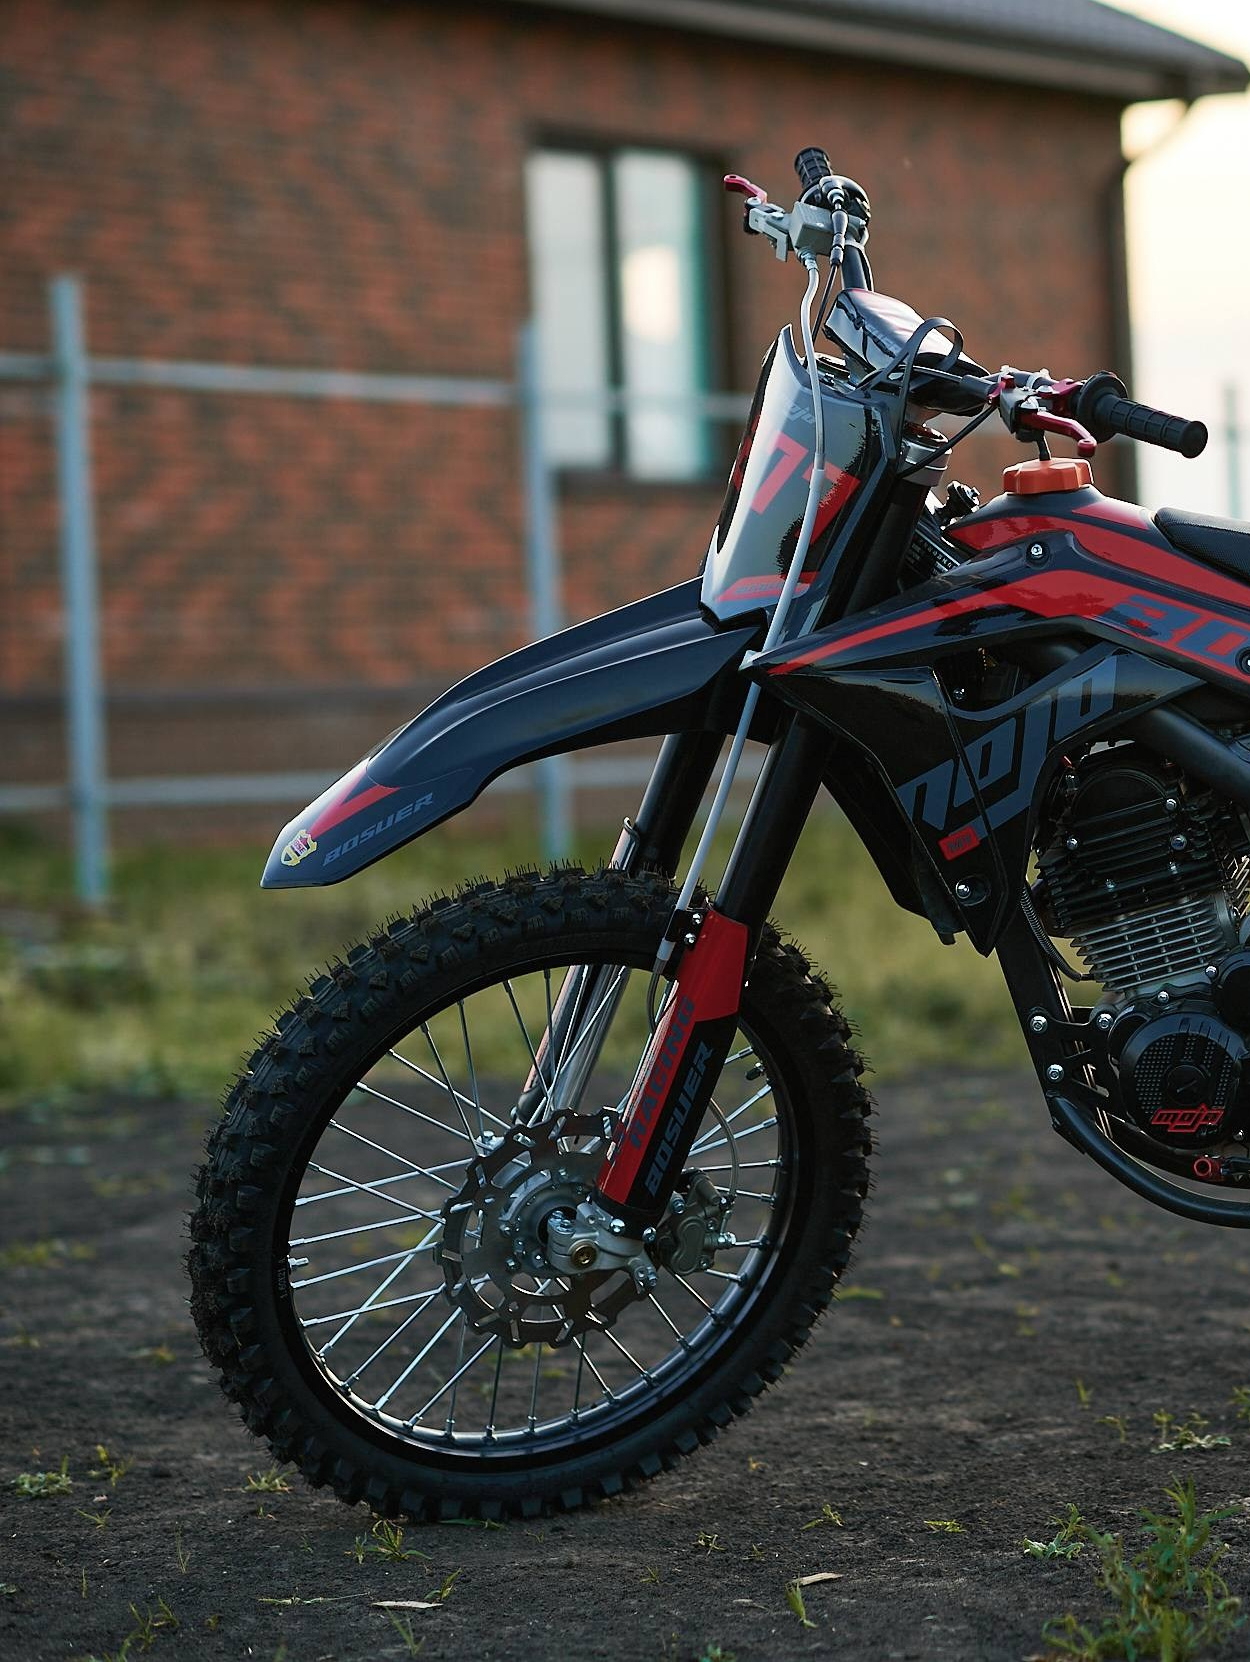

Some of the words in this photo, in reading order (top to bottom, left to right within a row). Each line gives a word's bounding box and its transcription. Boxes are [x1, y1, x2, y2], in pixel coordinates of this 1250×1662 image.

[322, 793, 433, 867] BOSUER
[645, 1041, 714, 1197] BOSUER
[1151, 1103, 1224, 1132] mojo
